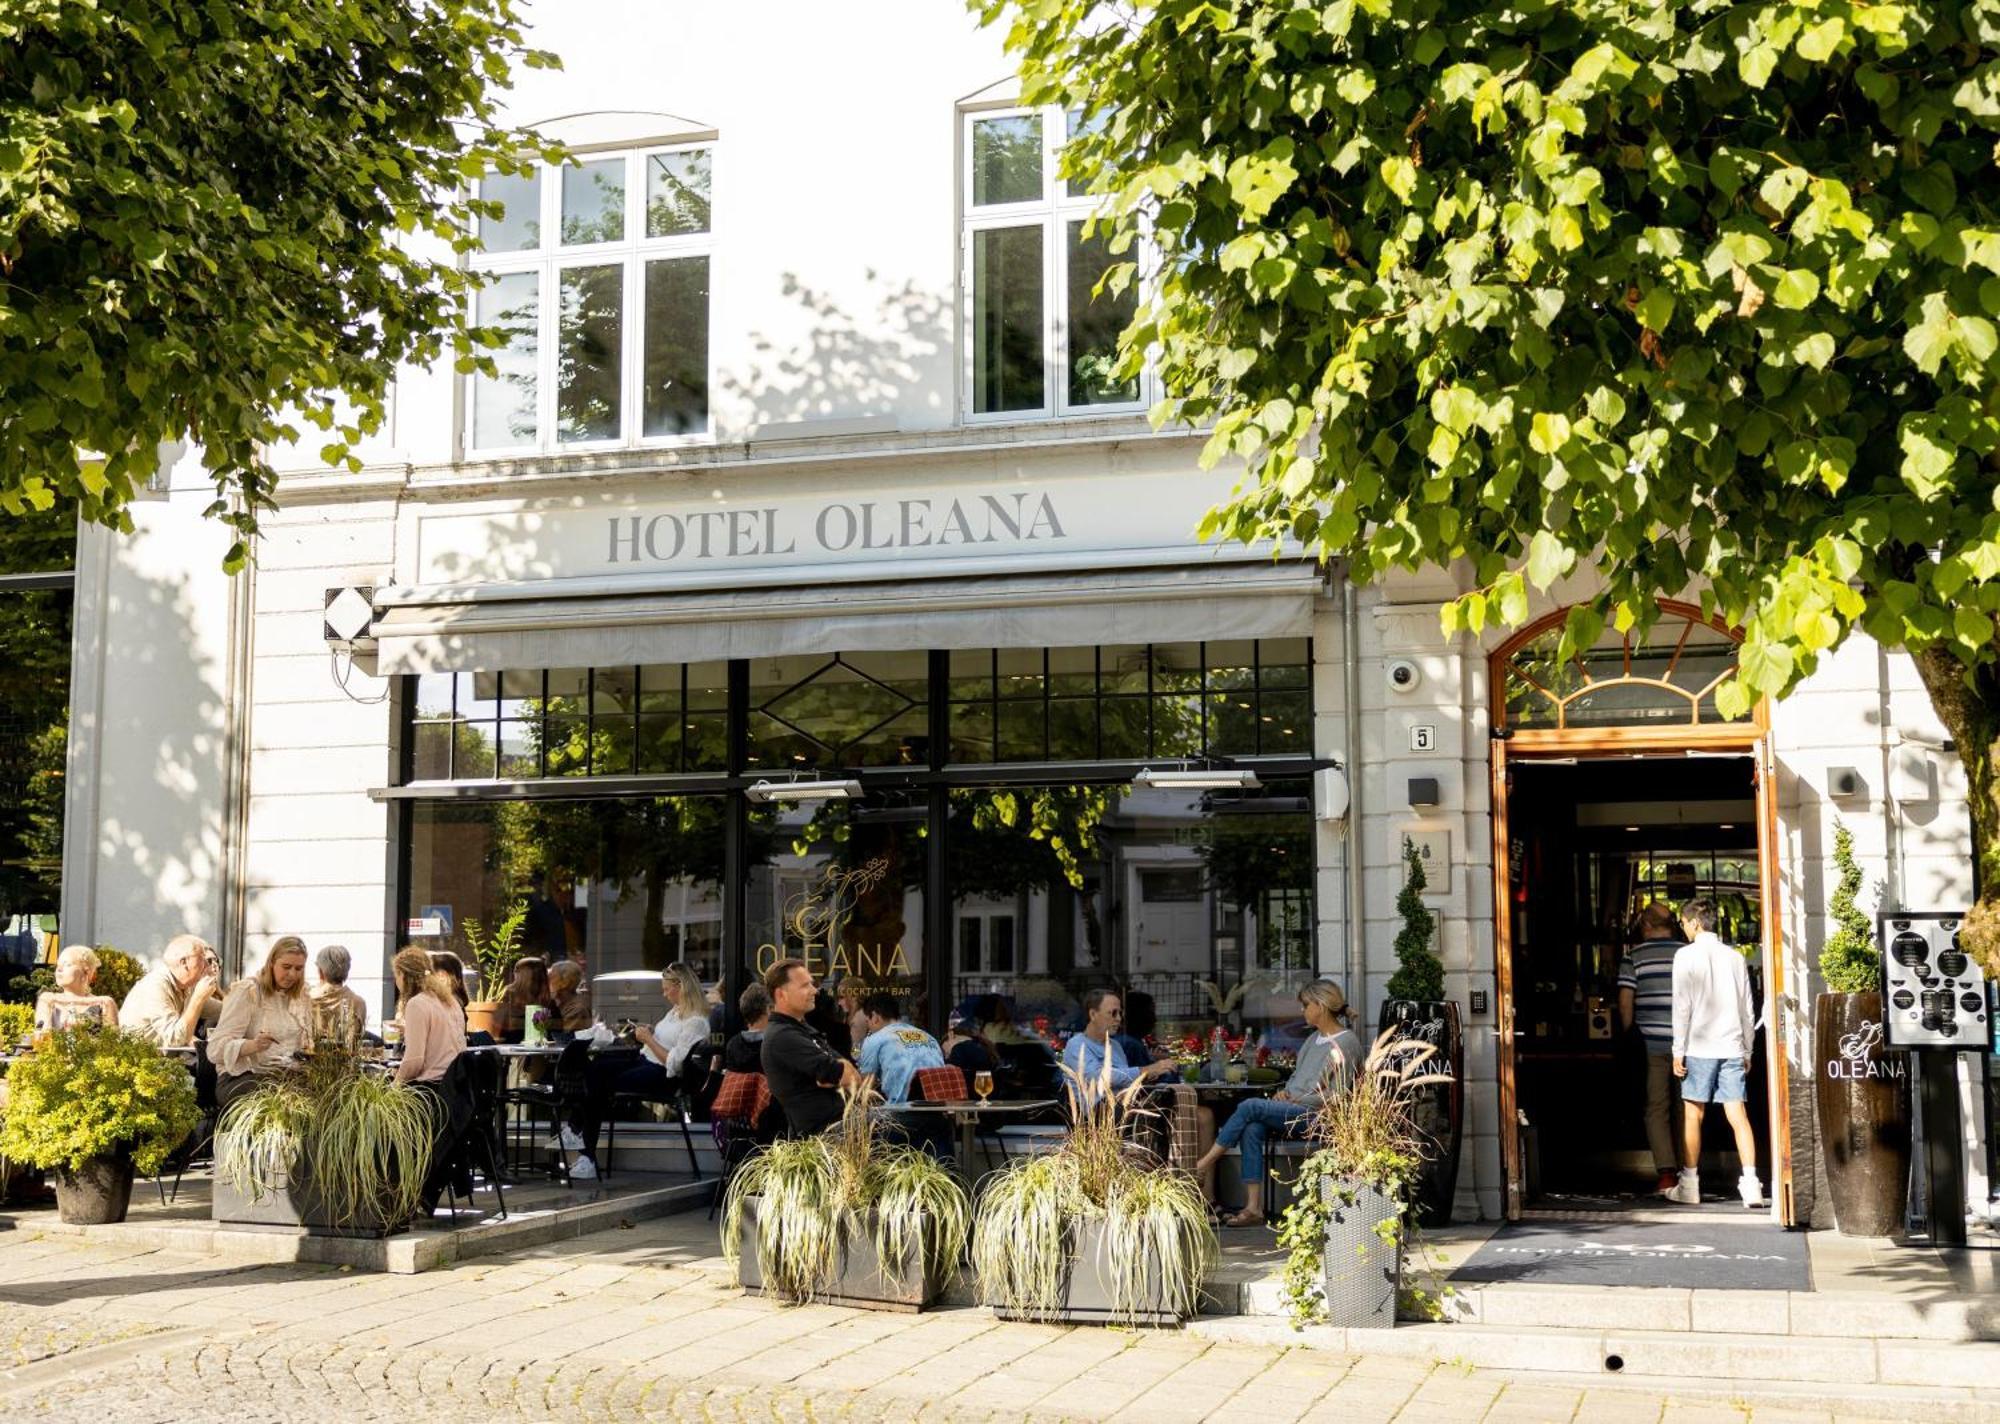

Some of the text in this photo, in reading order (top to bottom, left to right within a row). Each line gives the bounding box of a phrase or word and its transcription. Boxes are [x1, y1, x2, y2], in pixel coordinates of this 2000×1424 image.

[607, 491, 1067, 562] HOTEL OLEANA
[1418, 729, 1427, 747] 5
[891, 987, 911, 996] BAR
[1827, 1060, 1906, 1078] OLEANA
[1629, 1251, 1787, 1261] OLEANA
